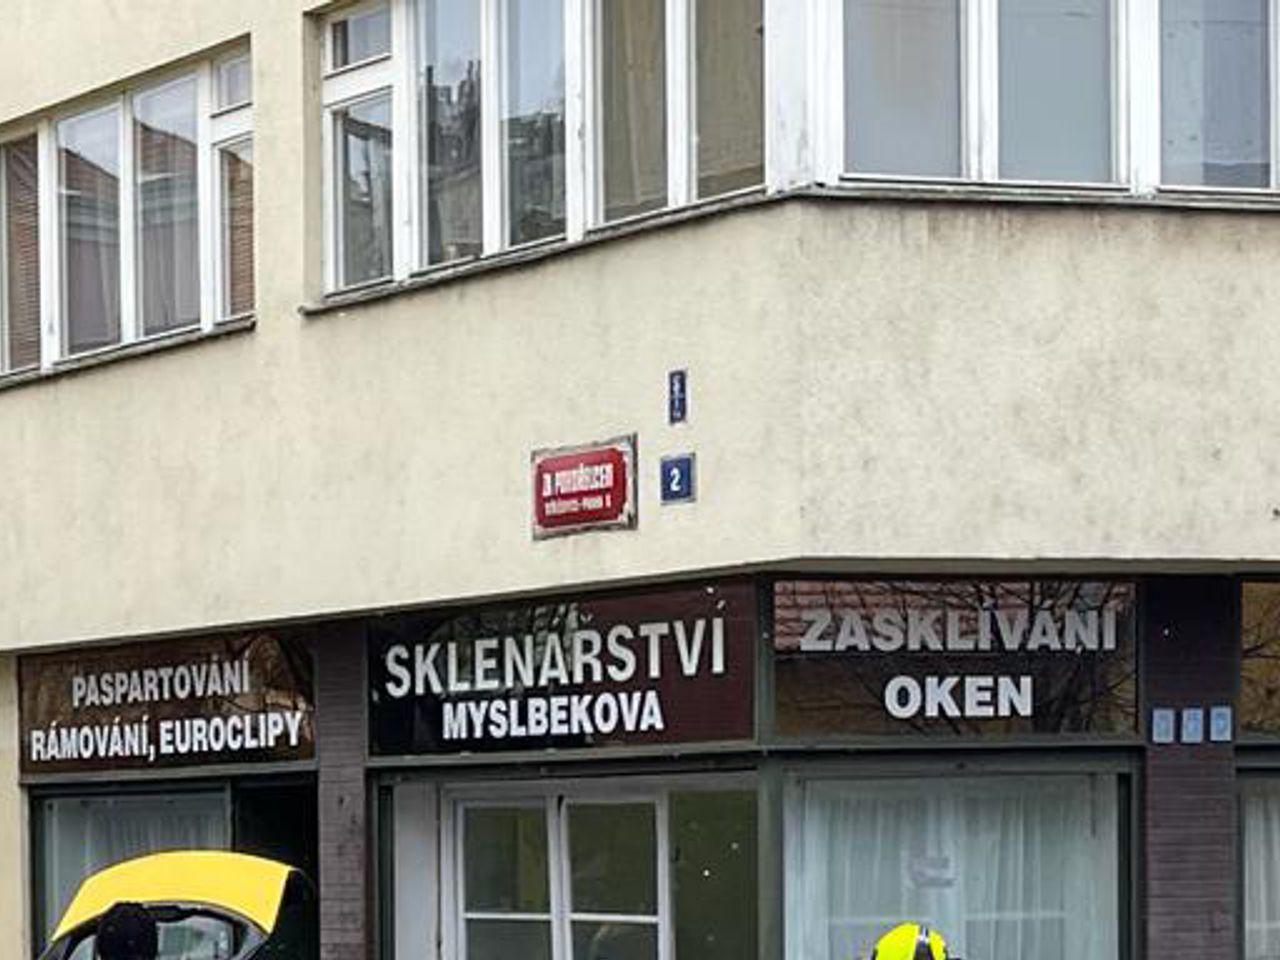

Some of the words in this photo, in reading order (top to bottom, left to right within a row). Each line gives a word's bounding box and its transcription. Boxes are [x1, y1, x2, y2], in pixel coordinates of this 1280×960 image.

[670, 467, 681, 491] 2
[385, 600, 726, 698] SKLENÁŘSTVÍ
[71, 651, 250, 707] PASPARTOVÁNÍ
[884, 674, 1033, 719] OKEN
[31, 714, 156, 762] RÁMOVÁNÍ,
[159, 710, 303, 755] EUROCLIPY
[442, 690, 664, 740] MYSLBEKOVA
